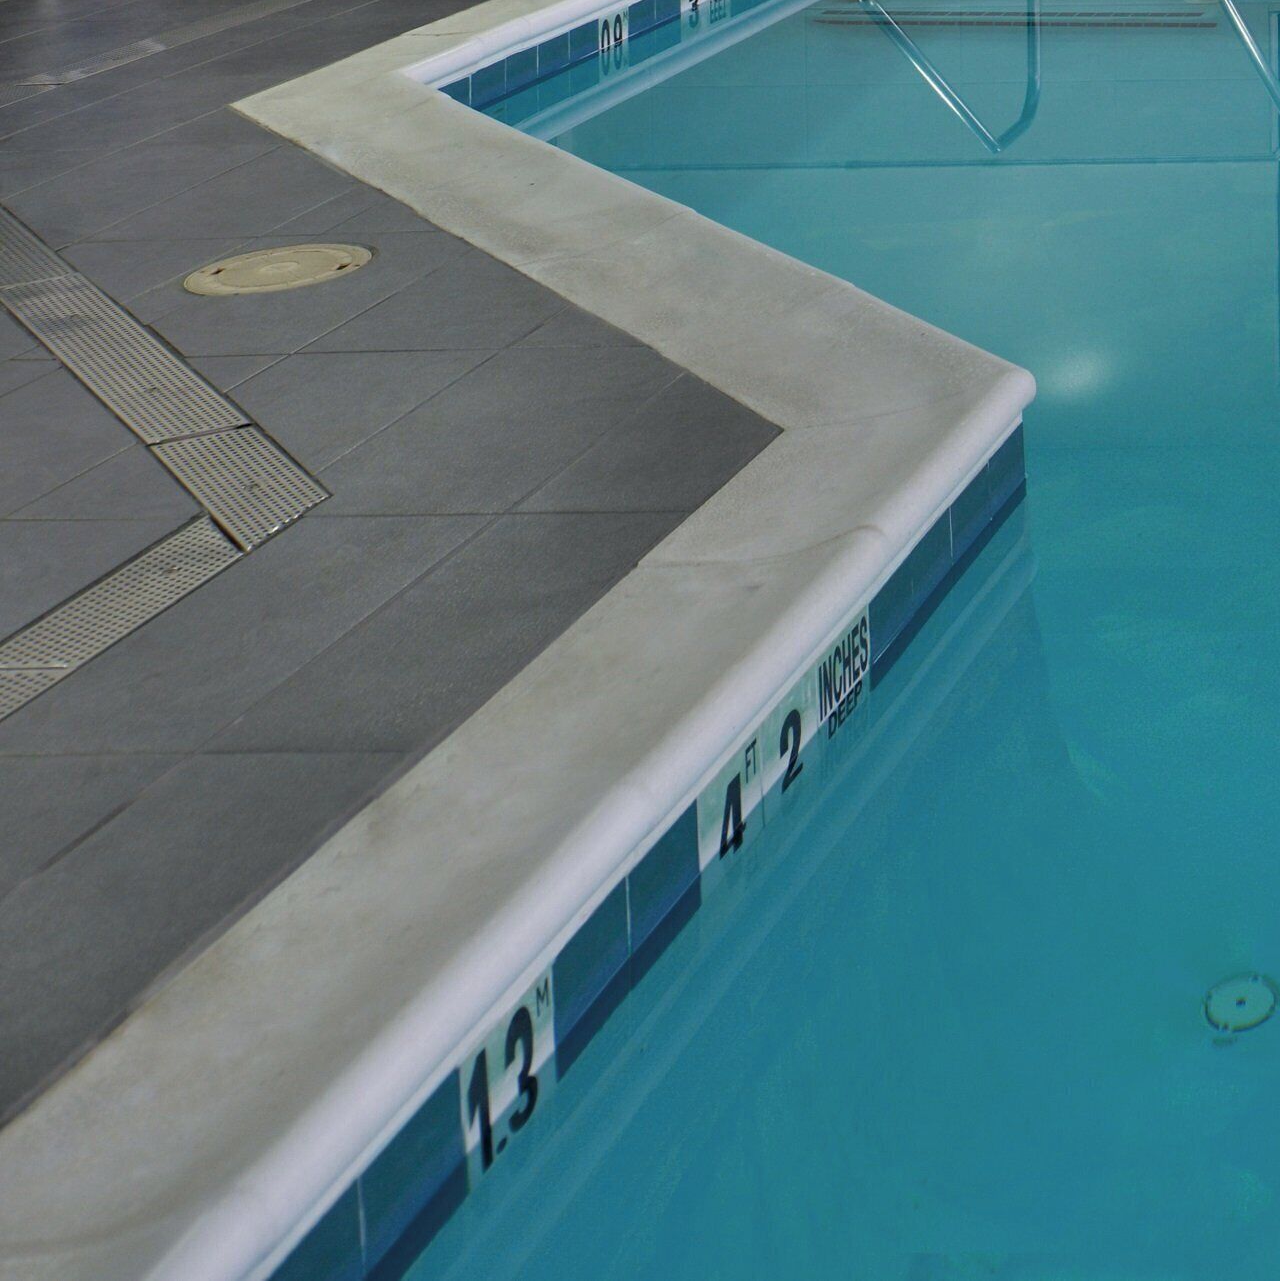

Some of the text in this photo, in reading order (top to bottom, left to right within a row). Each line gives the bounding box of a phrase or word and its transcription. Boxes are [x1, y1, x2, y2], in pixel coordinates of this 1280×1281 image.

[817, 615, 869, 723] INCHES
[828, 679, 863, 741] DEEP
[719, 709, 803, 861] 4 FT 2
[467, 1005, 539, 1175] 1.3
